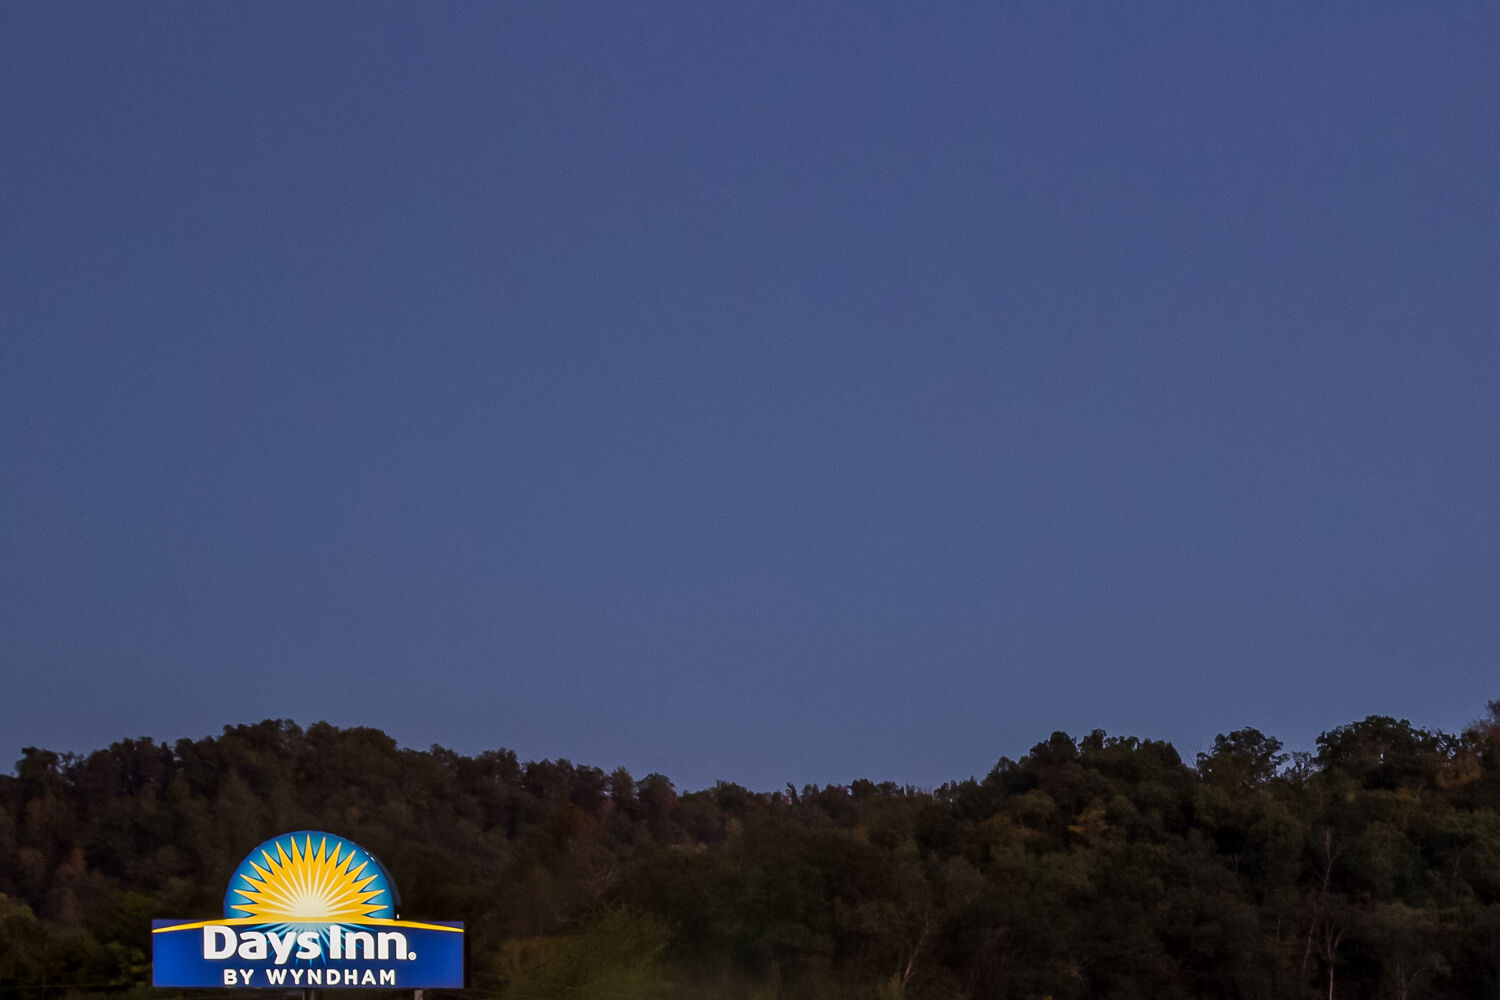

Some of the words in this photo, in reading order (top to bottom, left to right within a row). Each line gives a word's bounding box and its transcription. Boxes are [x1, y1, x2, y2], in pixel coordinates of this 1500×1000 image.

[203, 925, 322, 965] Days
[329, 925, 408, 960] Inn
[223, 969, 255, 985] BY
[266, 969, 396, 986] WYNDHAM
